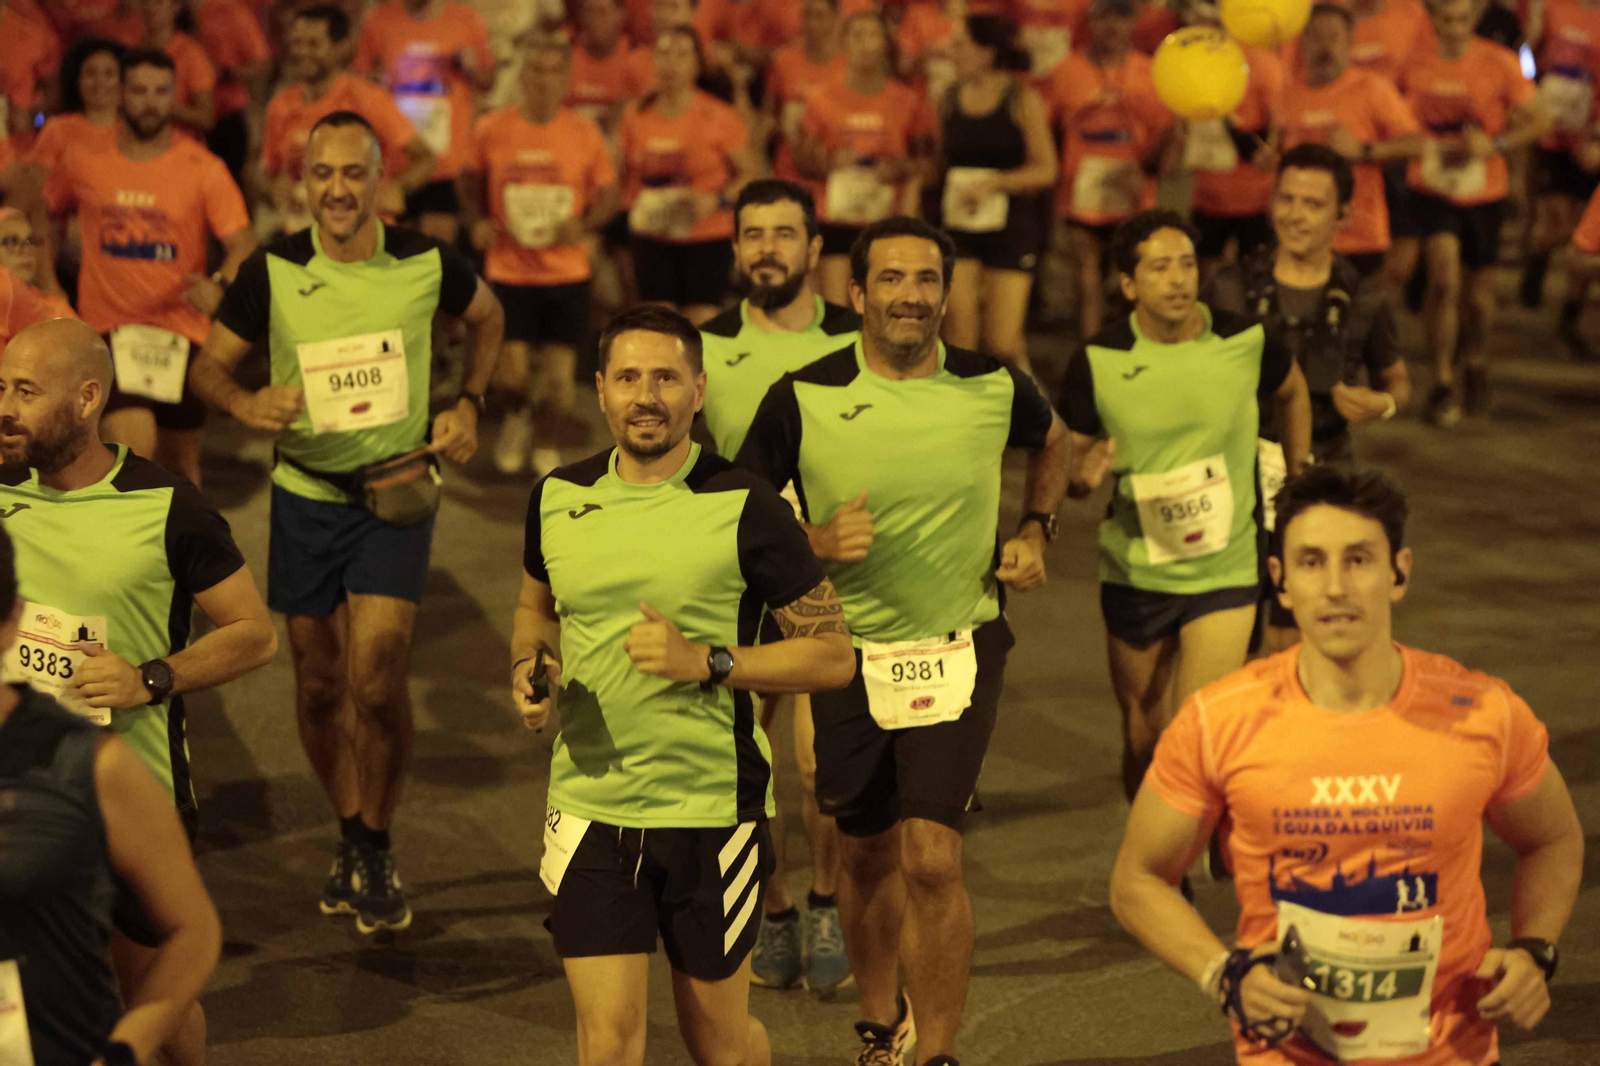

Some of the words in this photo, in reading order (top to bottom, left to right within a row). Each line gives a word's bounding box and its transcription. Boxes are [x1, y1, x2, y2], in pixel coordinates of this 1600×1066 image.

[329, 367, 382, 392] 9408
[1161, 494, 1213, 523] 9366
[19, 644, 74, 679] 9383
[891, 658, 945, 682] 9381
[1310, 774, 1402, 806] XXXV
[545, 805, 562, 834] 82
[1272, 807, 1343, 819] CARRERA
[1351, 804, 1434, 817] NOCTURNA
[1284, 818, 1434, 836] GUADALQUIVIR
[1314, 964, 1397, 1001] 1314
